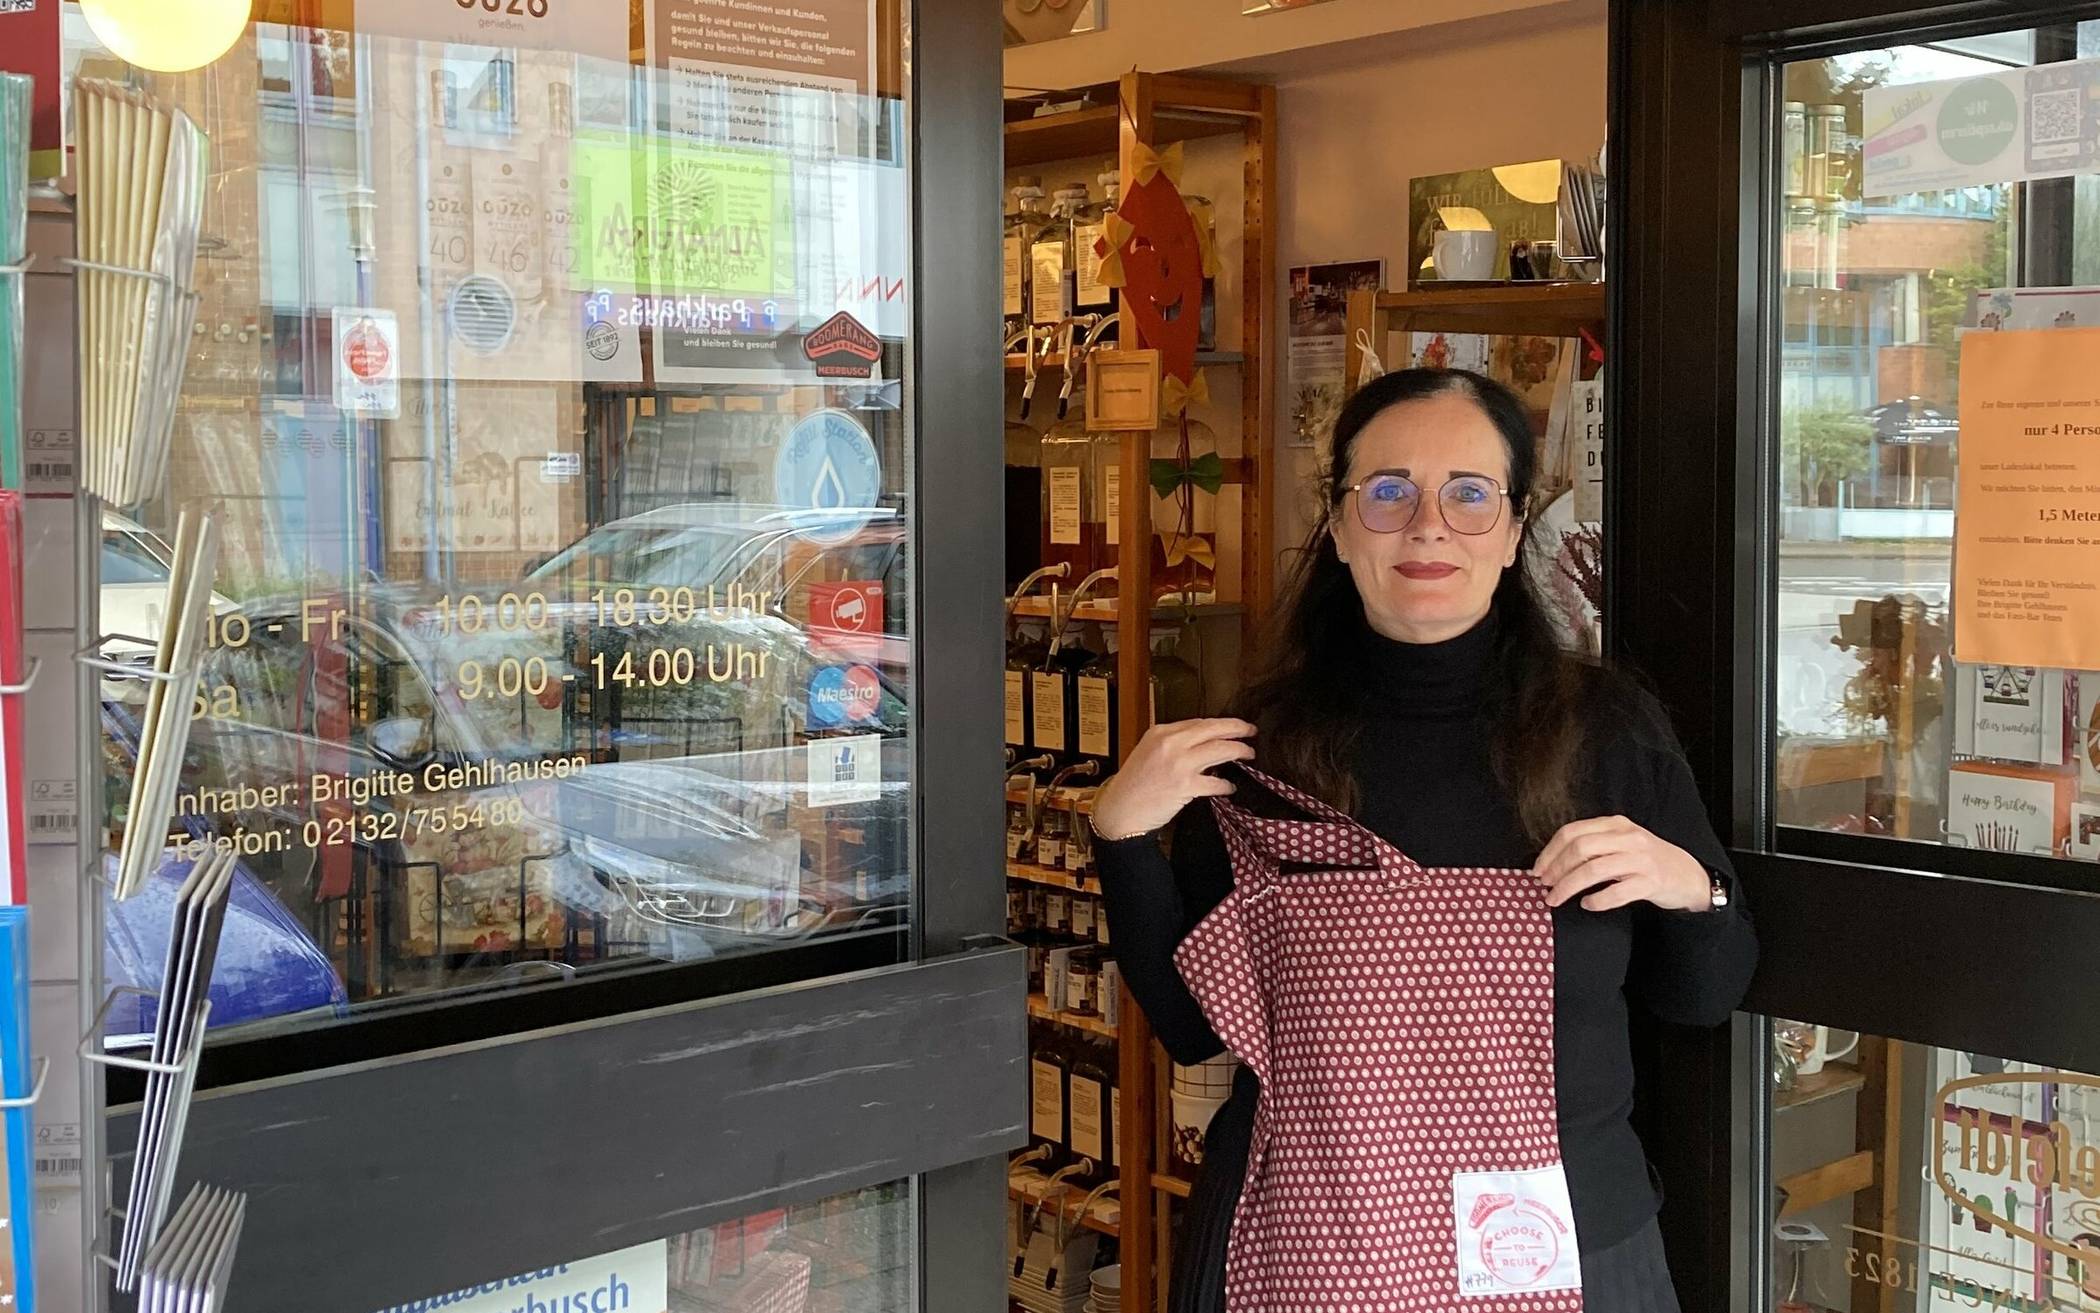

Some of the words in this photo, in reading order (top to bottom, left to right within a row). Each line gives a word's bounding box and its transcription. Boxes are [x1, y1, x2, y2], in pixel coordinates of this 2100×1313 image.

[729, 0, 773, 13] Kundinnen
[775, 8, 791, 16] und
[671, 10, 696, 22] damit
[699, 14, 712, 24] Sie
[714, 17, 731, 28] und
[733, 20, 756, 30] unser
[758, 22, 829, 40] Verkaufspersonal
[671, 25, 703, 36] gesund
[742, 33, 766, 44] bitten
[768, 37, 781, 47] wir
[801, 42, 813, 51] die
[815, 43, 856, 56] folgenden
[671, 37, 702, 49] Regeln
[704, 42, 714, 50] zu
[716, 43, 755, 56] beachten
[758, 50, 774, 59] und
[726, 73, 744, 82] stets
[812, 320, 875, 348] BOOMERANG
[684, 339, 699, 347] und
[702, 339, 730, 349] bleiben
[732, 340, 745, 349] Sie
[818, 366, 870, 376] MEERBUSCH
[2024, 426, 2048, 436] nur
[2051, 424, 2059, 435] 4
[2039, 509, 2057, 522] 1,5
[302, 599, 346, 643] Fr
[436, 592, 548, 637] 1000
[592, 586, 694, 628] 18.30
[708, 583, 771, 619] Uhr
[458, 656, 548, 701] 9.00
[591, 647, 694, 691] 14.00
[707, 643, 771, 682] Uhr
[817, 685, 874, 704] Maestro
[171, 776, 299, 817] nhaber:
[311, 769, 414, 806] Brigitte
[423, 755, 587, 793] Gehlhausen
[168, 826, 292, 863] Telefon:
[1494, 1226, 1544, 1241] CHOOSE
[1512, 1244, 1526, 1252] TO
[1502, 1257, 1538, 1267] REUSE
